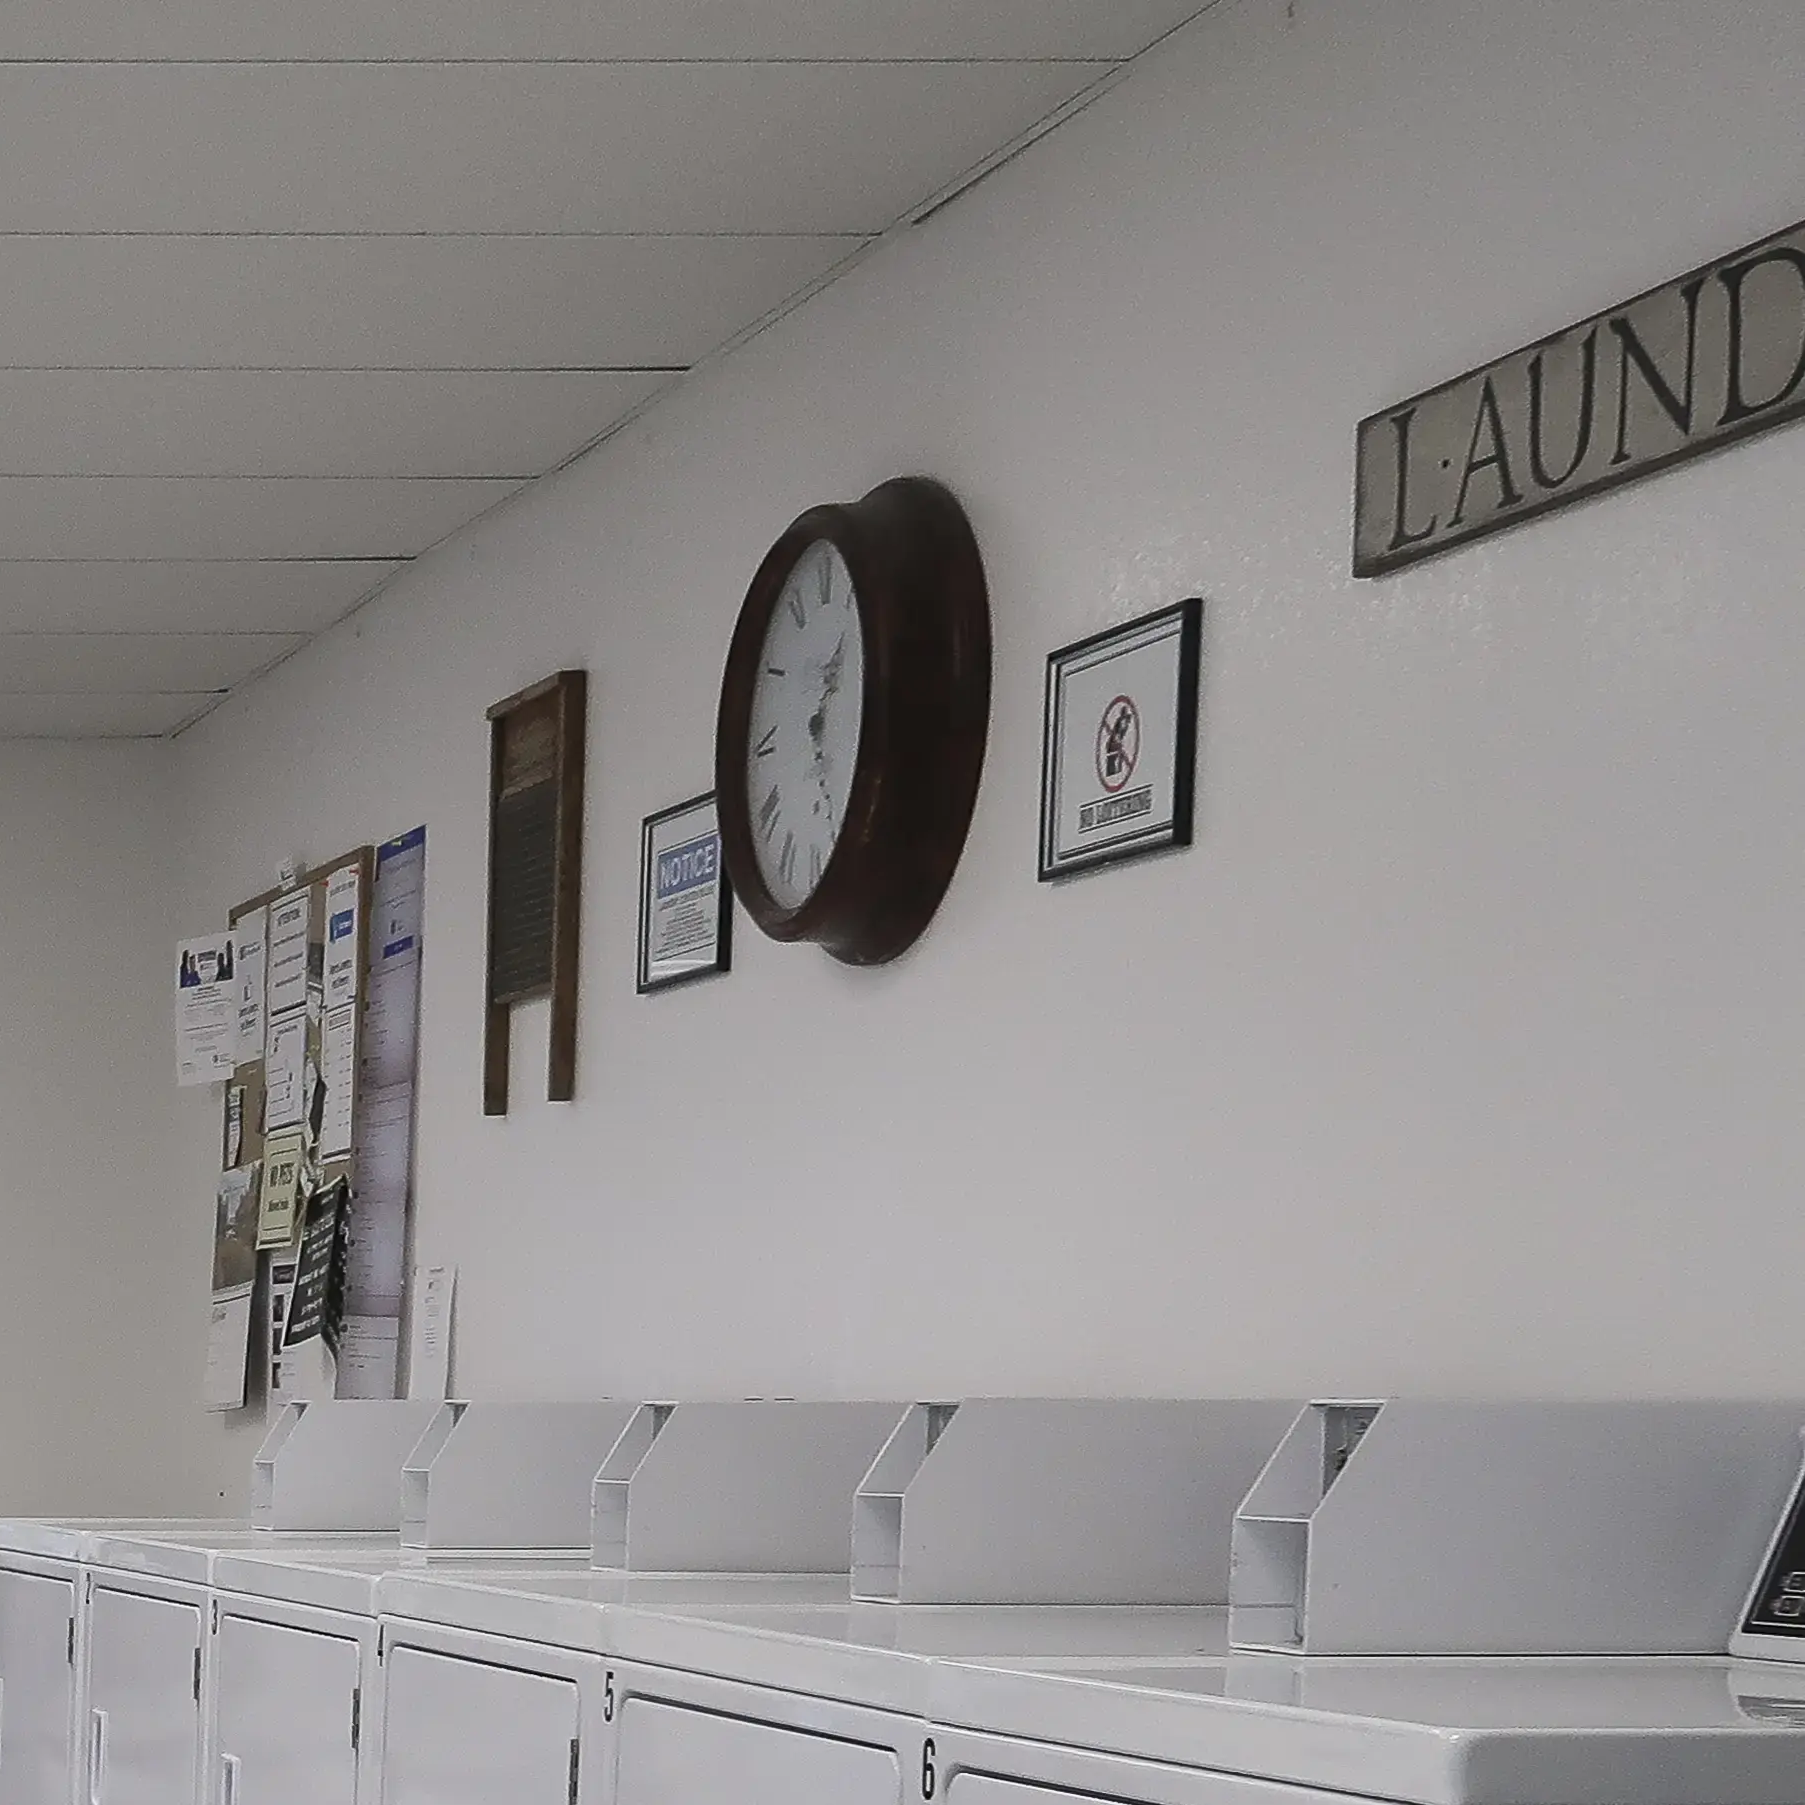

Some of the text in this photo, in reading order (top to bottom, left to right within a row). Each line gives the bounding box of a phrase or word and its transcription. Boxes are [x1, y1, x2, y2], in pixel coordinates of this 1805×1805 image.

[1387, 246, 1805, 551] LAUND
[660, 844, 716, 887] NOTICE
[604, 1671, 614, 1722] 5
[920, 1736, 938, 1802] 6
